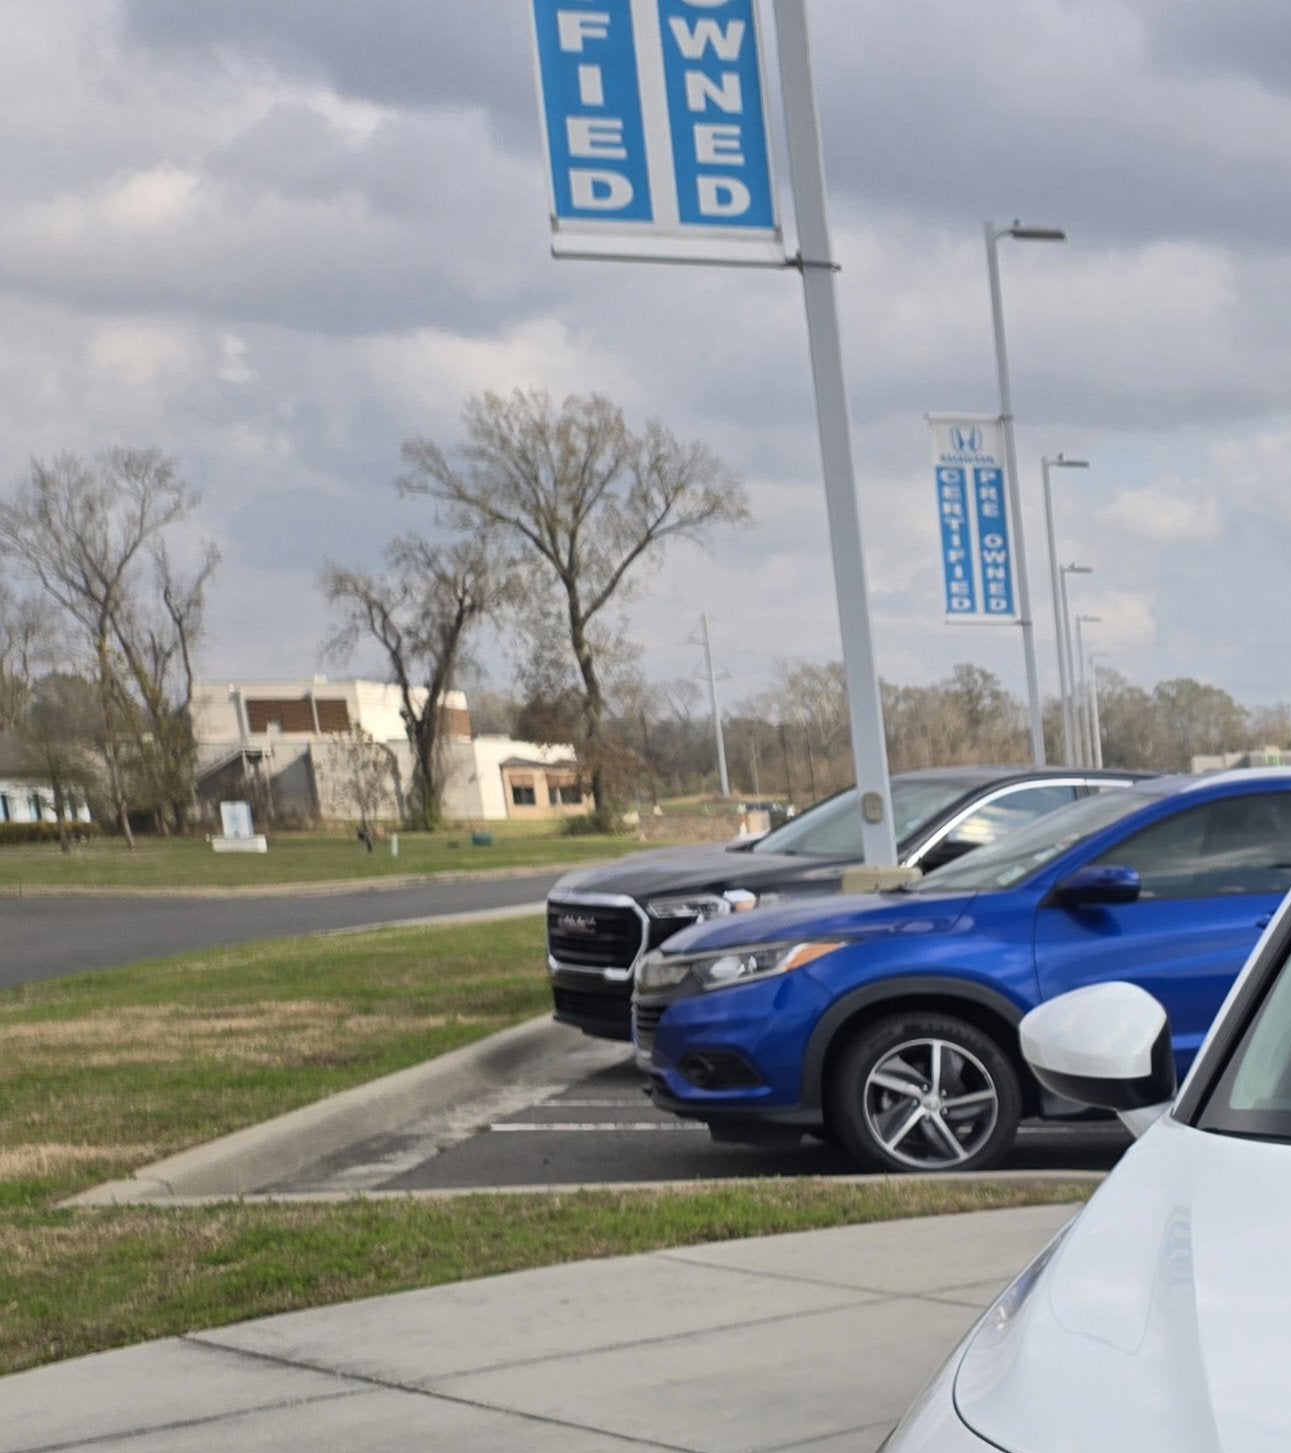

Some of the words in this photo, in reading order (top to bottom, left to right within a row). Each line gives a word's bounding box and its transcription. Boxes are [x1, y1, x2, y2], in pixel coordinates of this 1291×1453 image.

[557, 0, 634, 210] FIED
[667, 0, 751, 217] WNED
[940, 468, 971, 611] CERTIFIED
[979, 470, 999, 518] PRE
[983, 533, 1008, 611] OWNED
